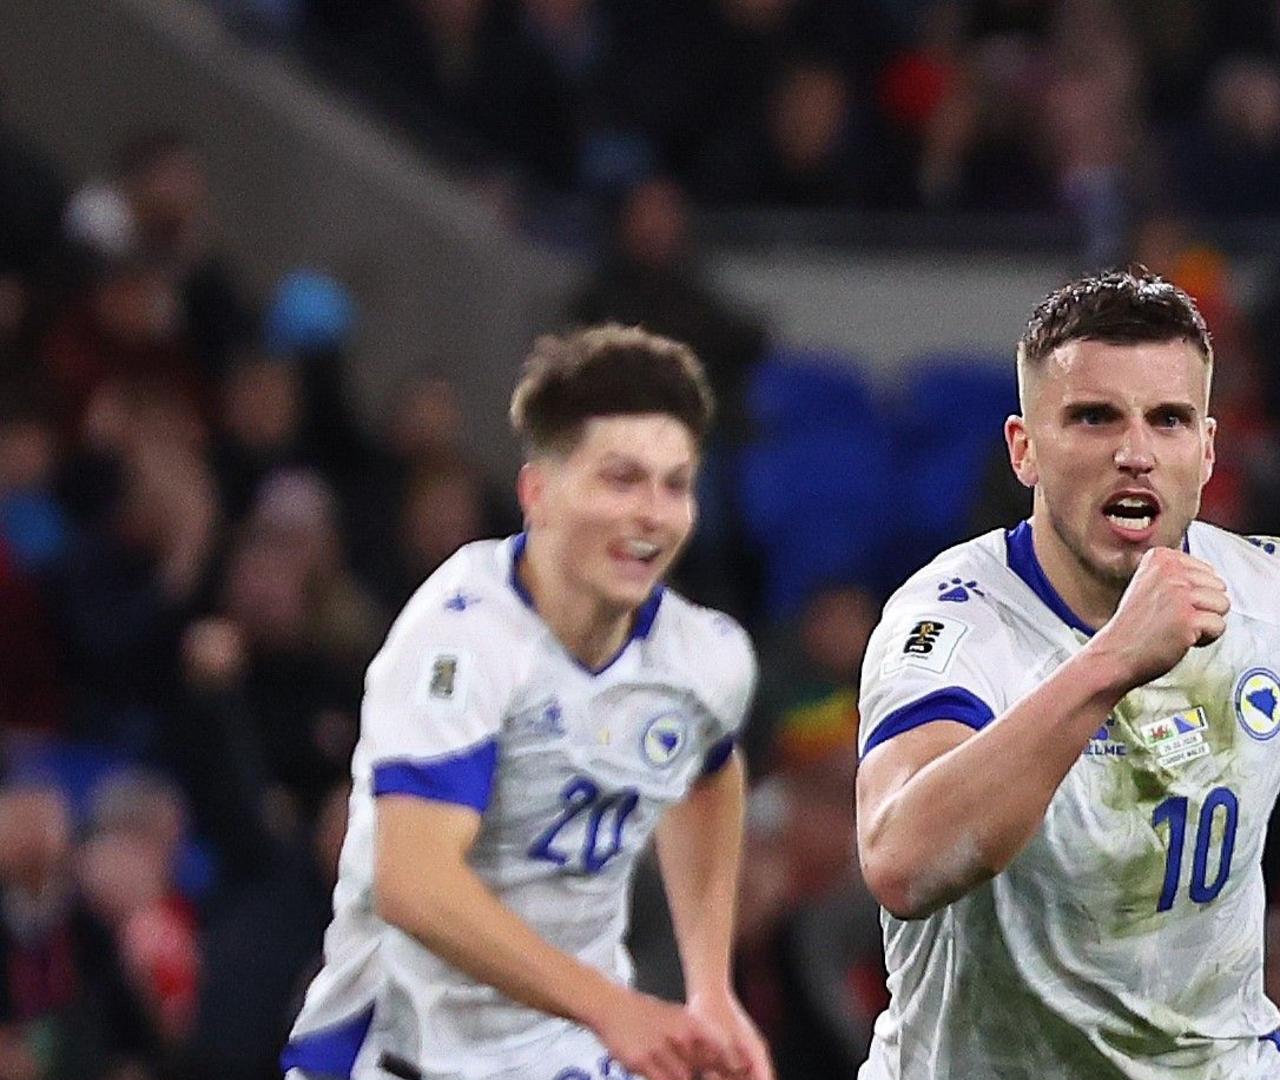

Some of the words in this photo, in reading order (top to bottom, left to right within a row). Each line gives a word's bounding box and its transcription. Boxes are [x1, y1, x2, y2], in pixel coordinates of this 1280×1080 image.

[1082, 744, 1127, 756] ELME
[527, 774, 640, 874] 20
[1152, 786, 1239, 913] 10
